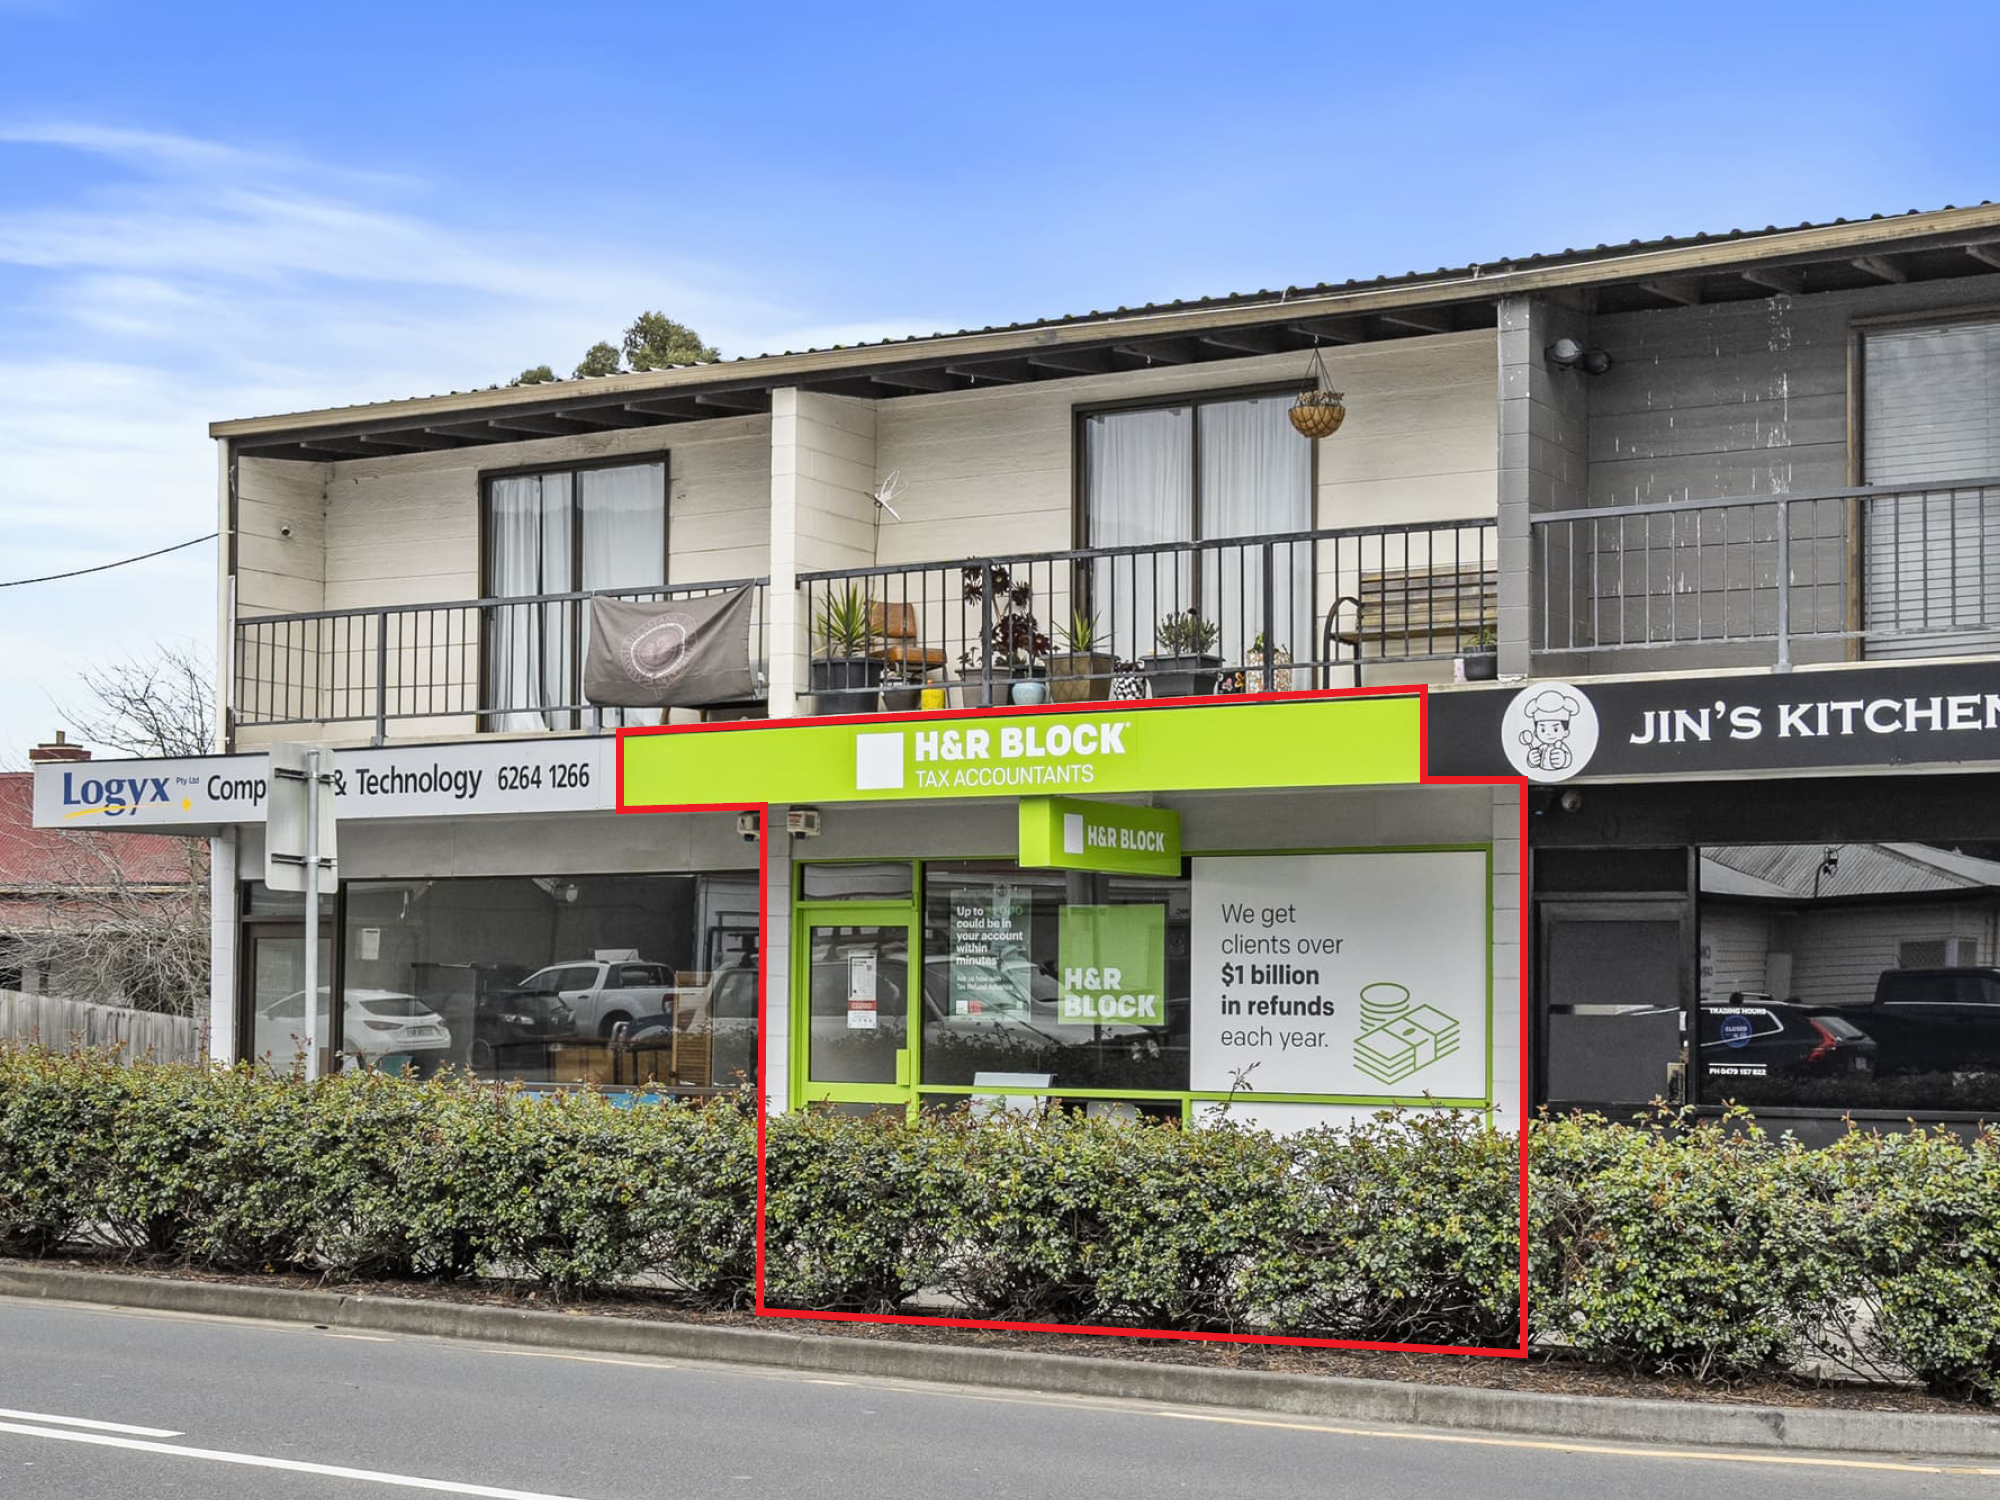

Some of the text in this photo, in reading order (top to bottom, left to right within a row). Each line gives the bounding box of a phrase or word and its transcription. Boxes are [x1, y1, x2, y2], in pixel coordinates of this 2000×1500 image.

[915, 722, 1126, 761] H&R BLOCK
[176, 777, 188, 786] Pty
[207, 763, 590, 806] Comp & Technology 6264 1266
[915, 764, 1094, 788] TAX ACCOUNTANTS
[63, 772, 170, 816] Logyx
[1088, 825, 1165, 852] H&R BLOCK
[956, 906, 972, 917] Up
[973, 906, 984, 916] to
[1221, 903, 1296, 928] We get
[956, 918, 1012, 929] could be in
[956, 931, 1023, 942] your account
[956, 943, 988, 953] within
[1221, 933, 1344, 954] clients over
[1064, 967, 1122, 990] H&R
[1221, 962, 1319, 987] $1 billion
[1064, 994, 1156, 1018] BLOCK
[1221, 994, 1335, 1016] in refunds
[1709, 1007, 1741, 1015] TRADING
[1221, 1025, 1329, 1052] each year.
[1709, 1067, 1720, 1075] PH
